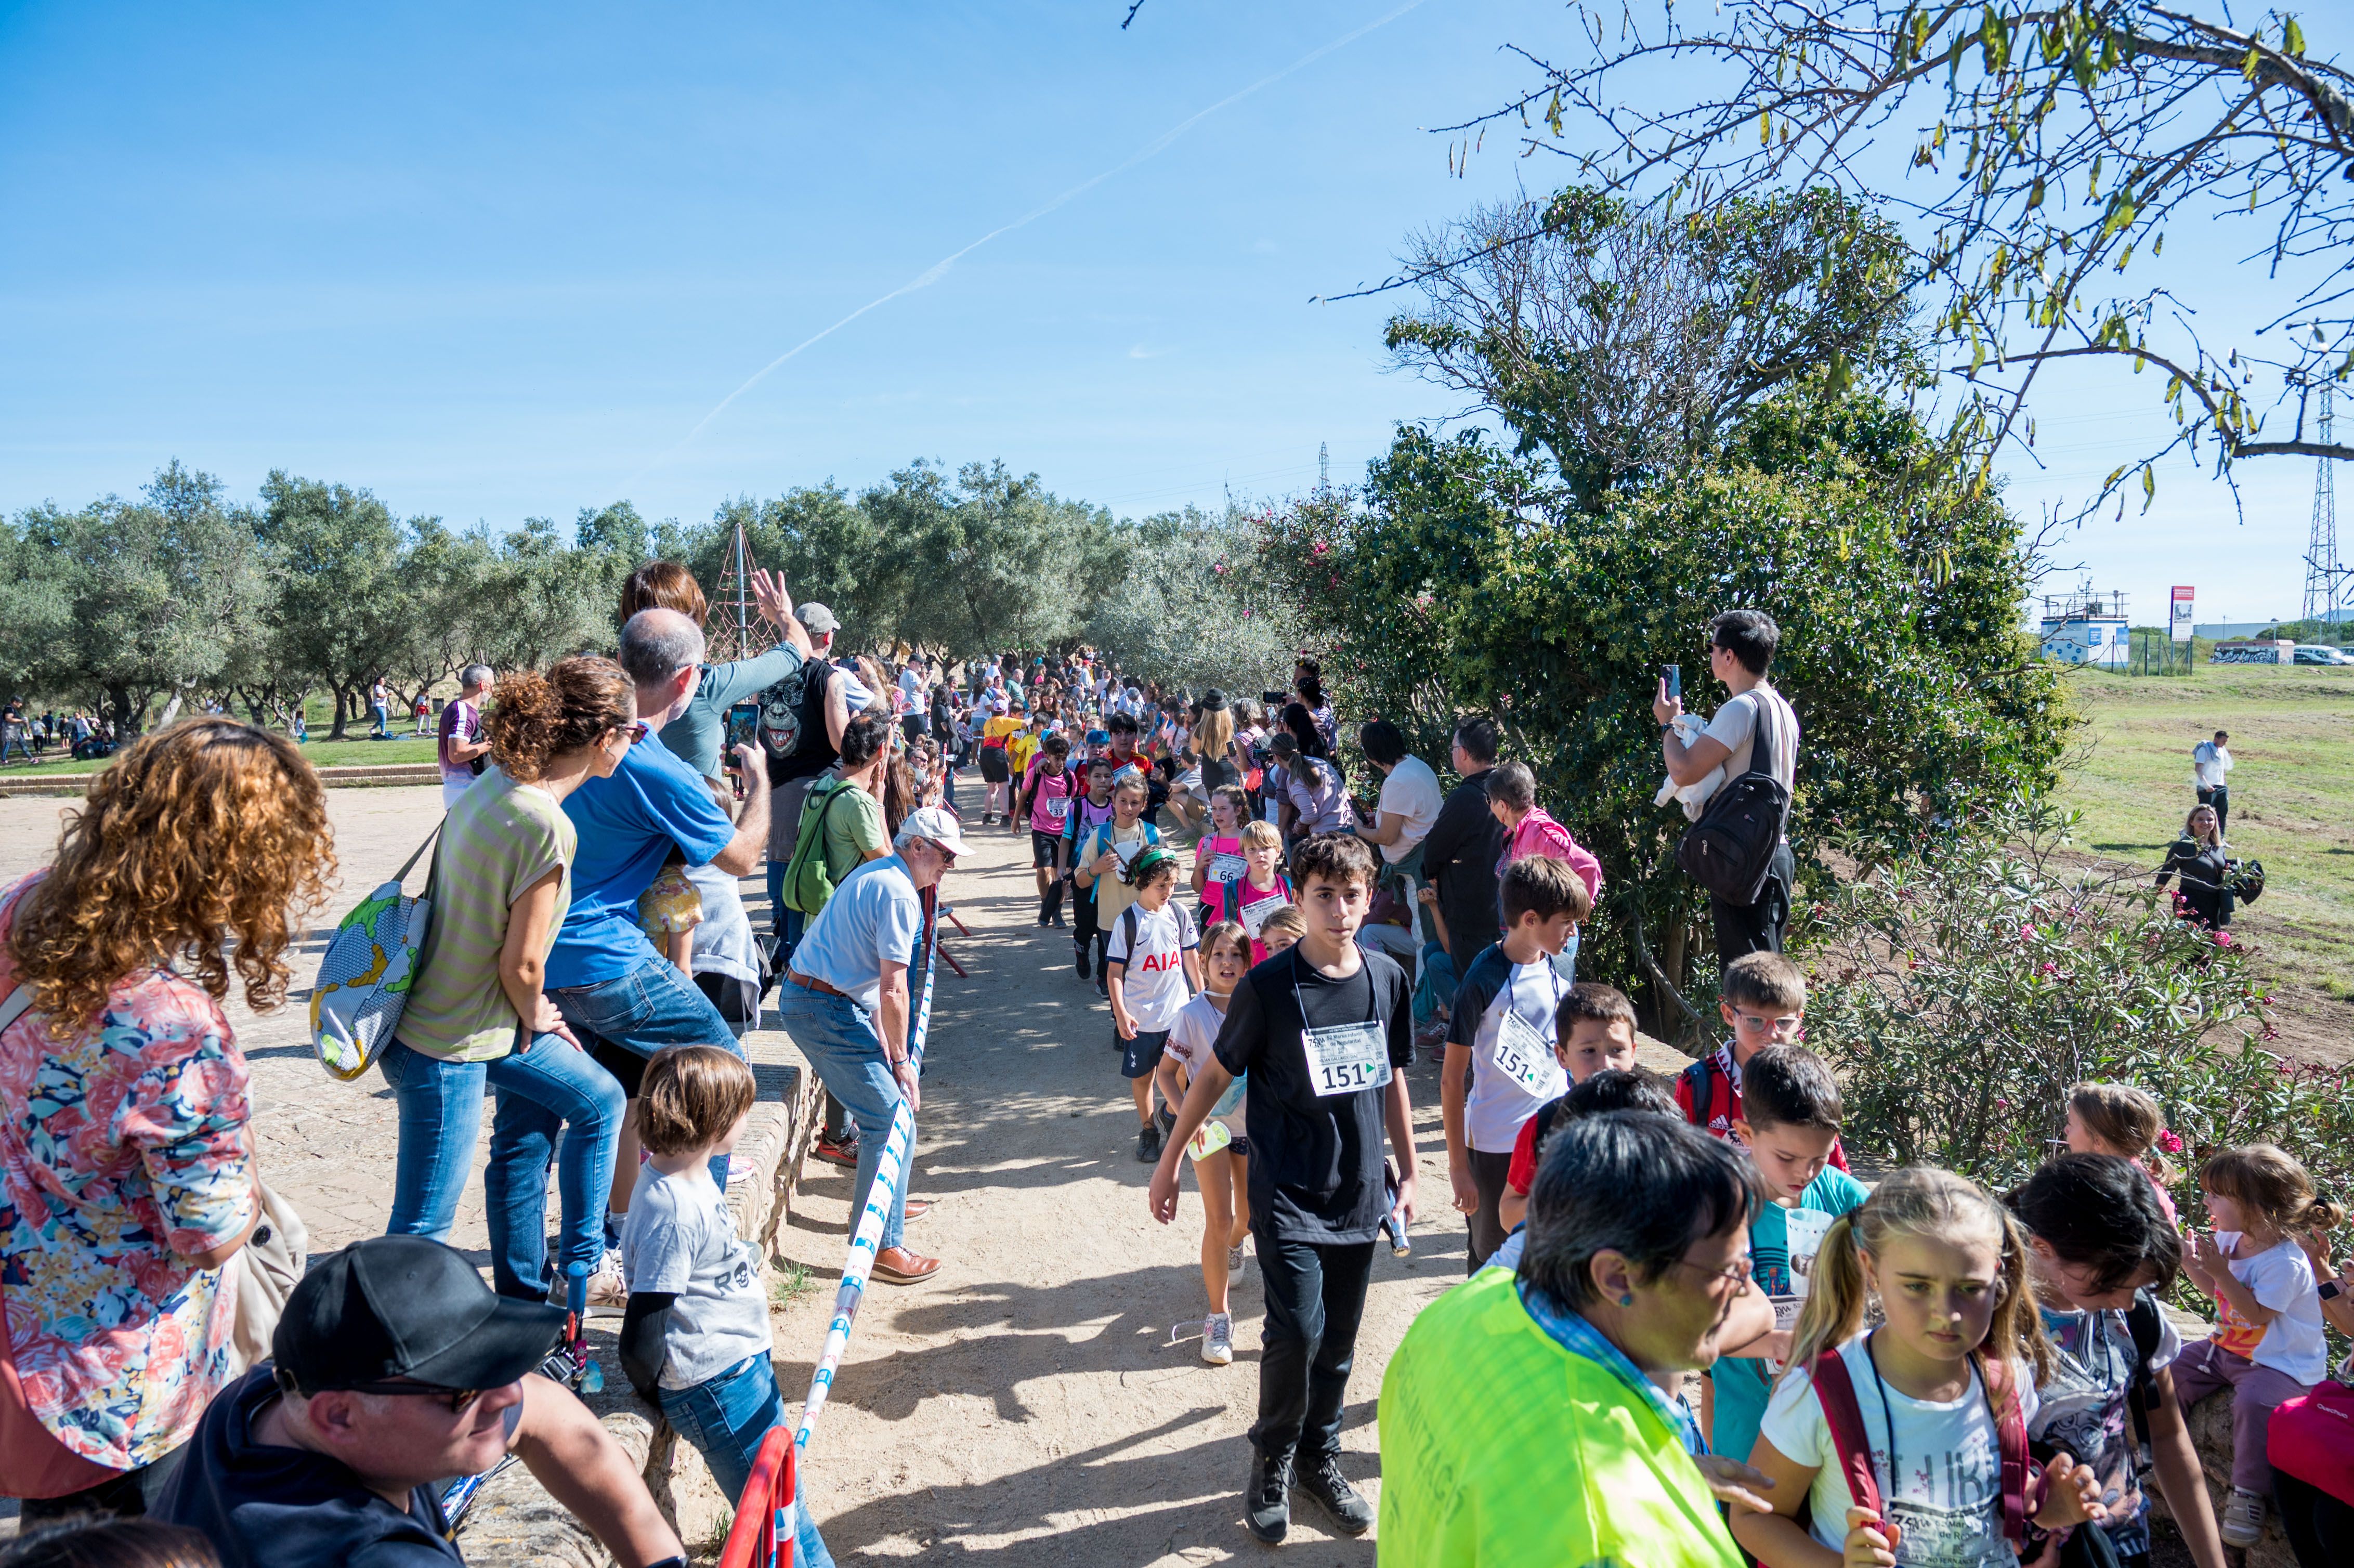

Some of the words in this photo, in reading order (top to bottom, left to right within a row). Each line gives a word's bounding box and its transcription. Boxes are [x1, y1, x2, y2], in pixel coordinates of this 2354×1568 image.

[1220, 871, 1234, 882] 66
[1142, 951, 1180, 972] AIA
[1496, 1046, 1529, 1083] 151
[1322, 1063, 1366, 1089] 151
[2317, 1403, 2348, 1419] Quechua
[1939, 1530, 1951, 1538] de
[1898, 1551, 1918, 1560] JULIA
